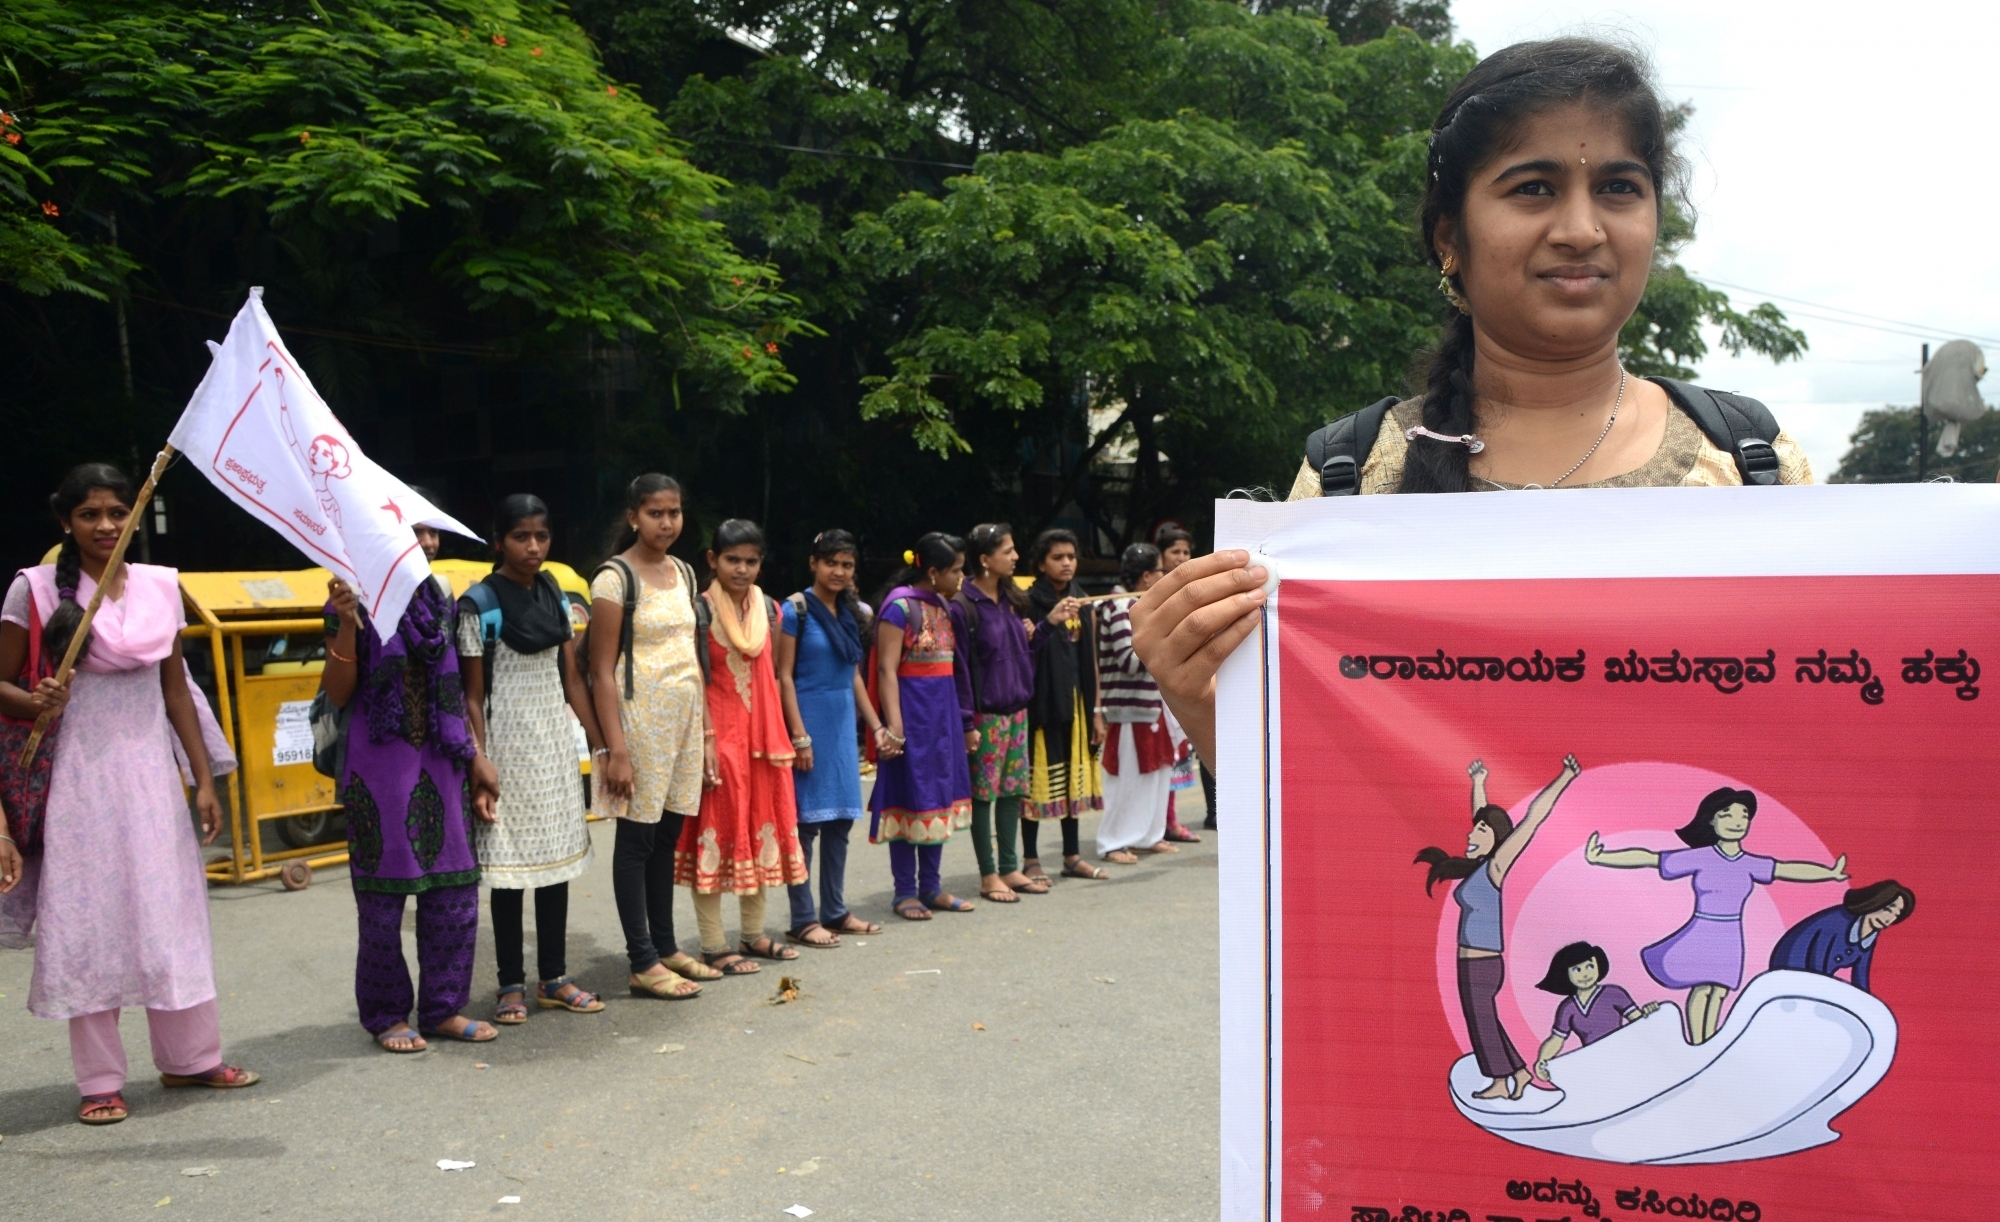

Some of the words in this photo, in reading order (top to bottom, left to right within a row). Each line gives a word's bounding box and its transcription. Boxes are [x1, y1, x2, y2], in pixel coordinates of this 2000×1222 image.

[1605, 649, 1775, 694] ಋತುಸ್ರಾವ
[1796, 649, 1884, 705] ನಮ್ಮ
[1902, 649, 1980, 701] ಹಕ್ಕು
[1506, 1177, 1600, 1217] ಅದನ್ನು
[1615, 1187, 1761, 1222] ಕಸಿಯದಿರಿ
